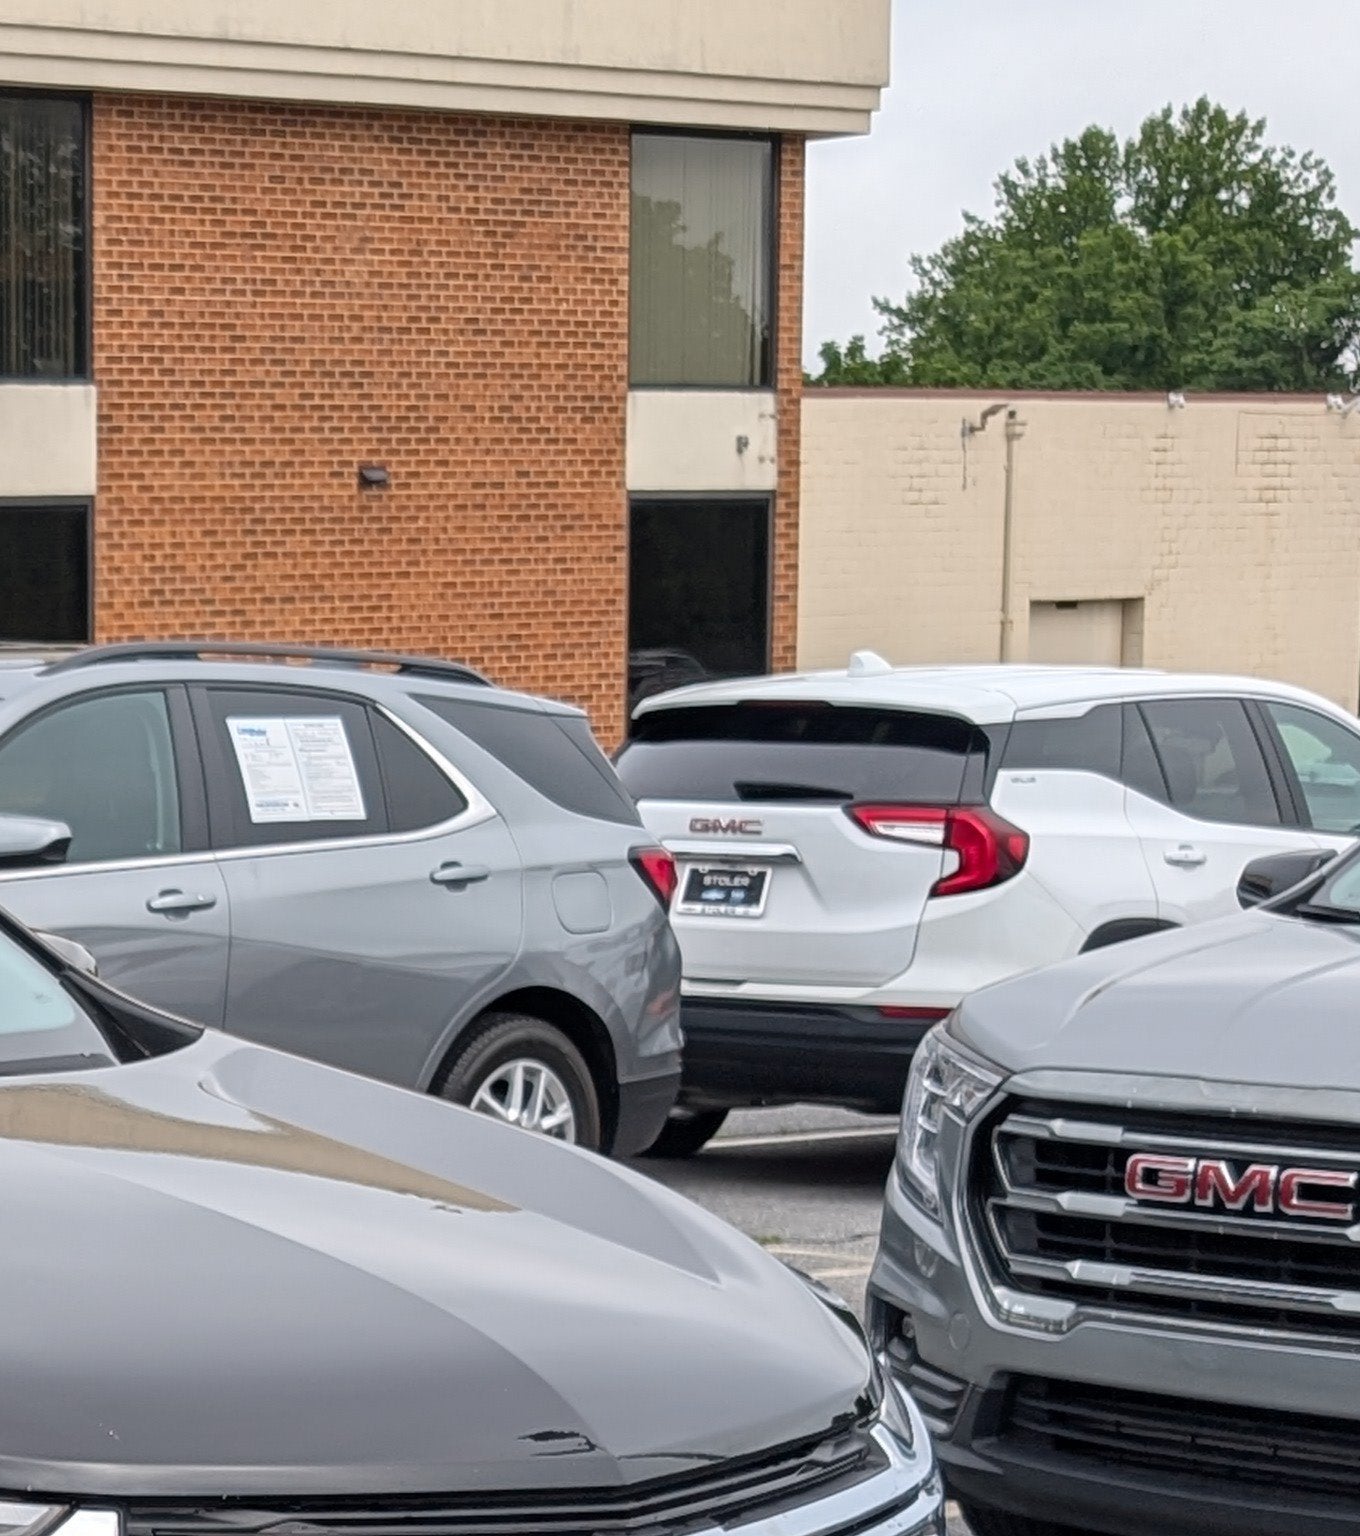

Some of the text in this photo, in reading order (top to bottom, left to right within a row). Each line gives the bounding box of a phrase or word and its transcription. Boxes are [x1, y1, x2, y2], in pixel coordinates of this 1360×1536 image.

[688, 817, 763, 836] GMC
[701, 874, 752, 888] STOLER
[1124, 1152, 1359, 1221] GMC
